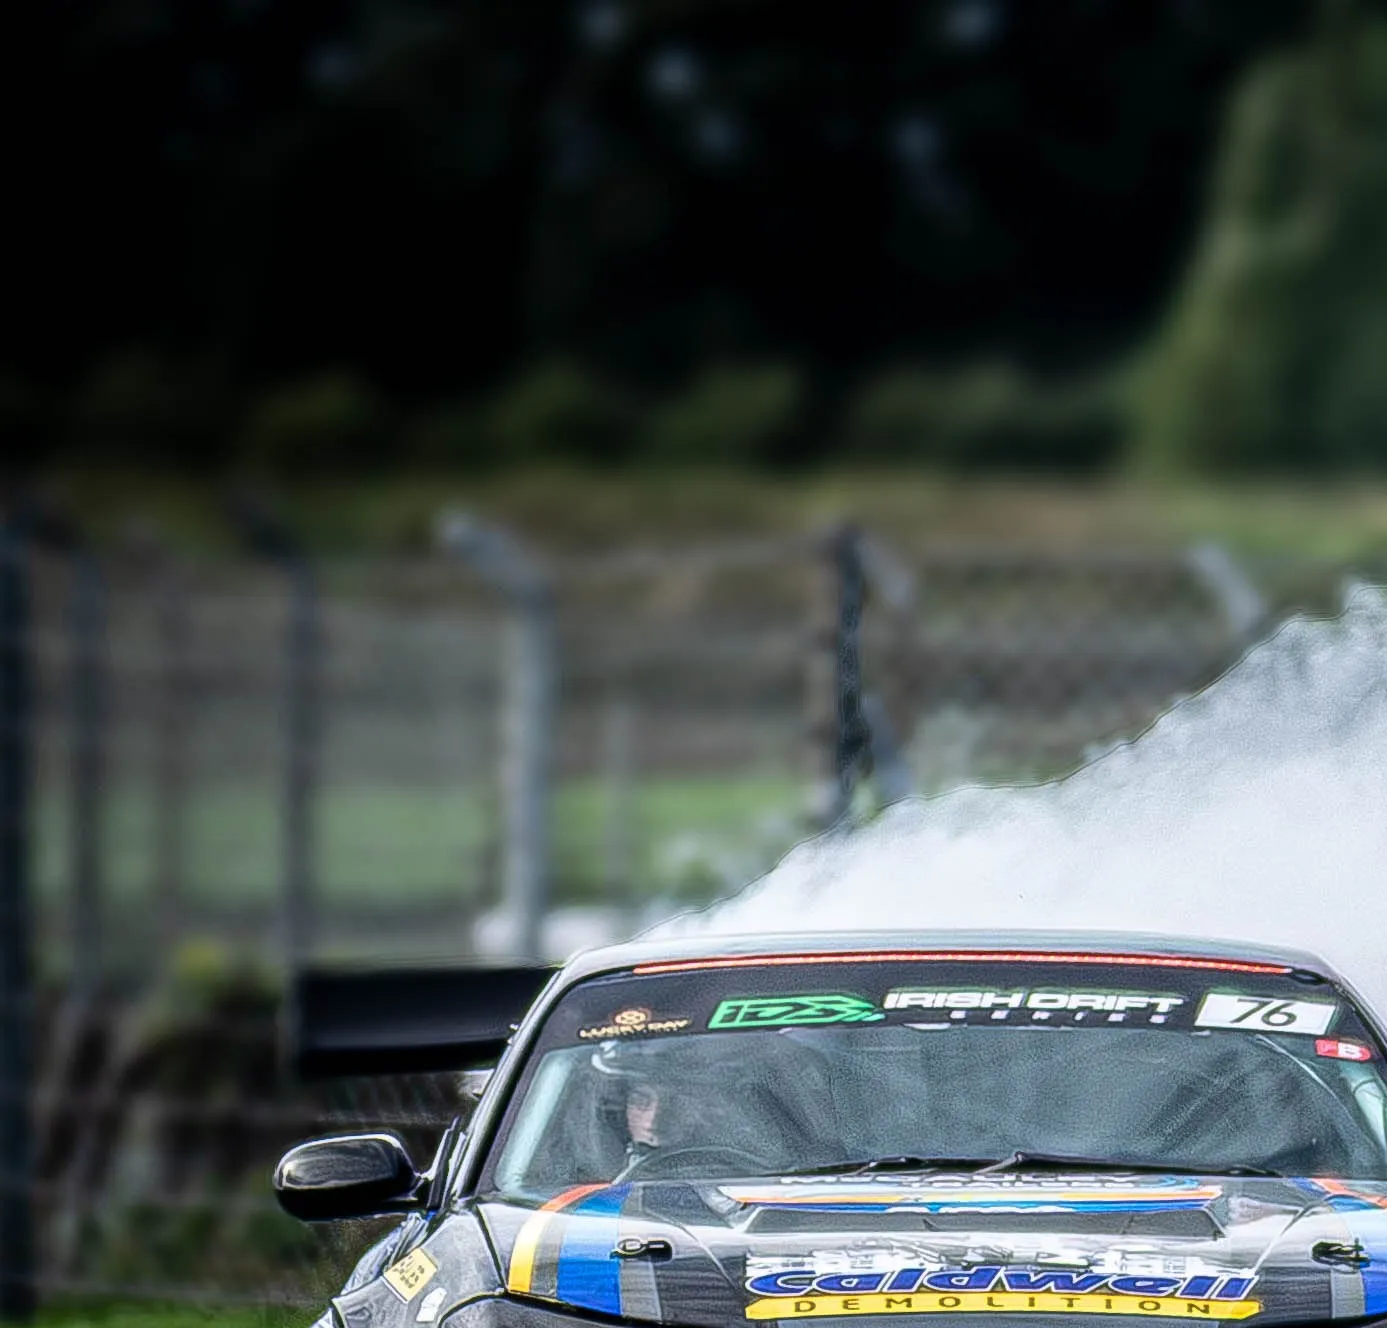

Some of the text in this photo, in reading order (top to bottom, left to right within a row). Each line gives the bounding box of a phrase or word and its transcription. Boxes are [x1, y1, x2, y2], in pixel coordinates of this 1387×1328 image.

[884, 992, 1184, 1013] IRISH DRIFT
[1229, 998, 1298, 1027] 76
[794, 1296, 1211, 1314] DEMOLITION
